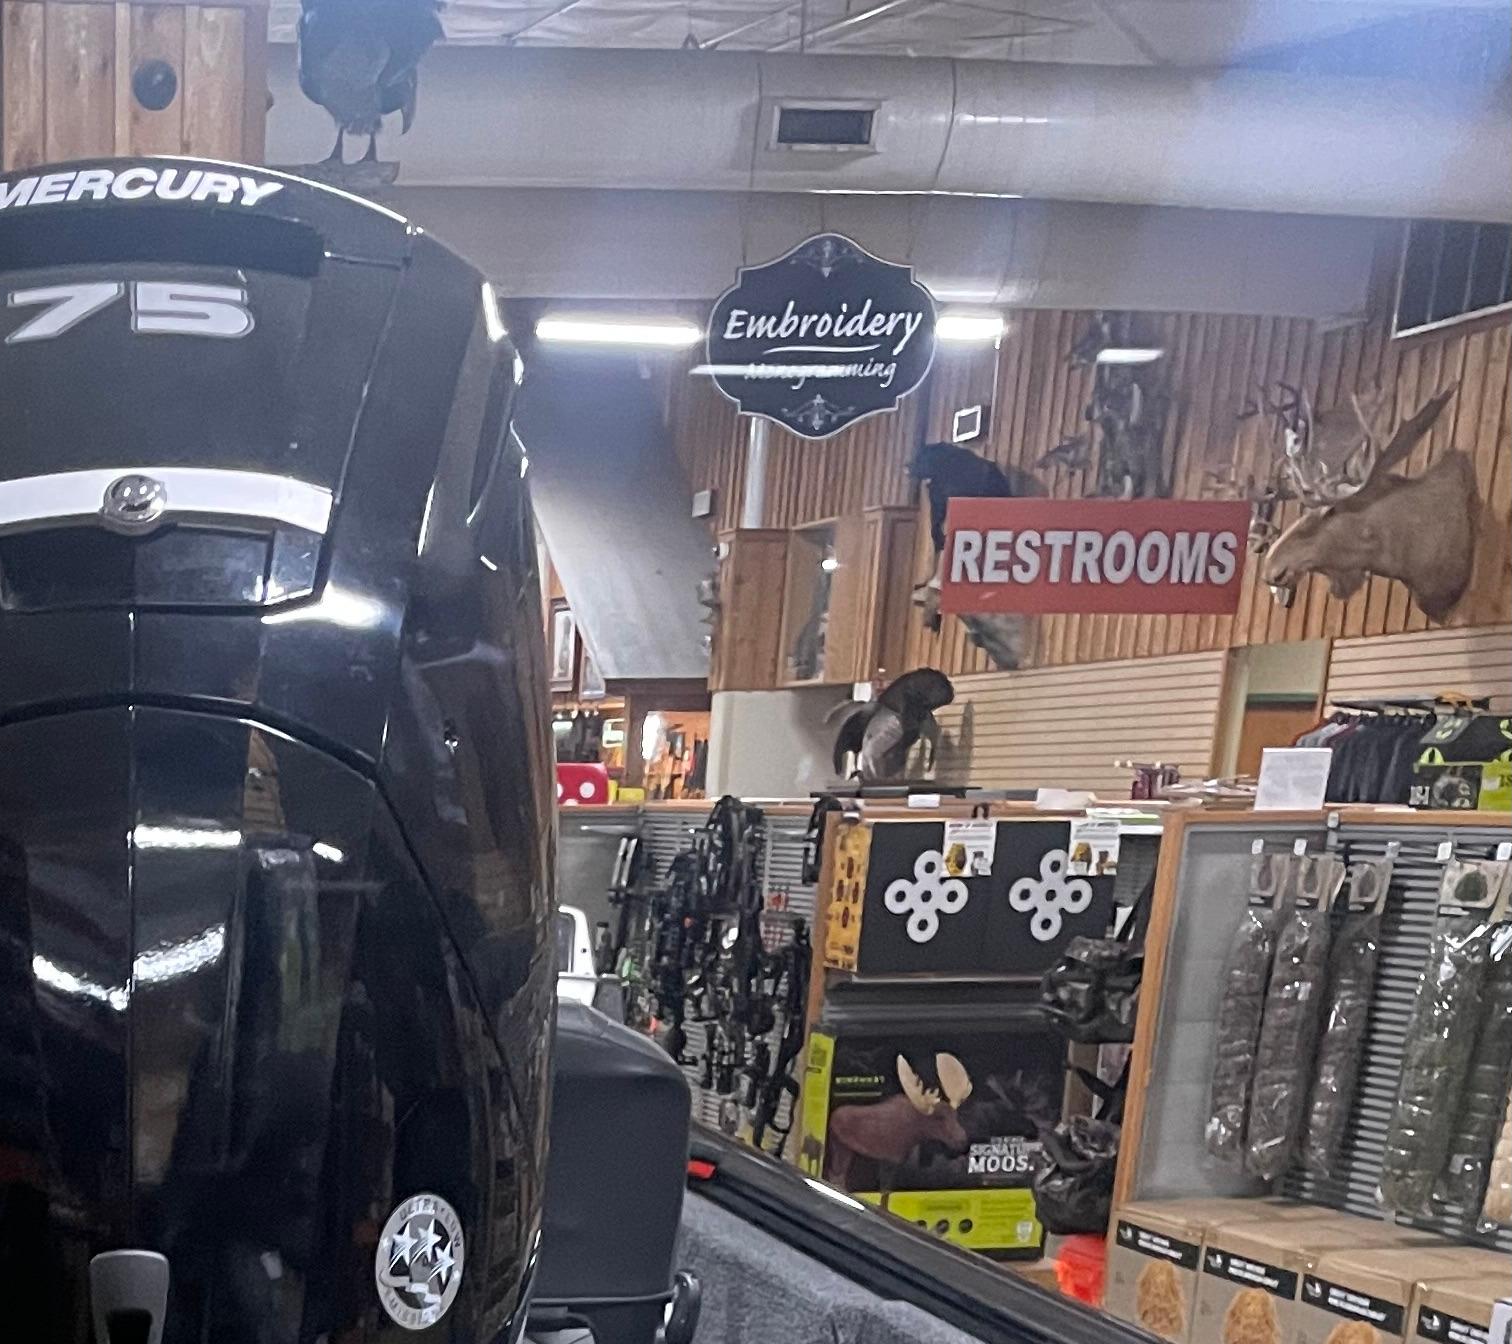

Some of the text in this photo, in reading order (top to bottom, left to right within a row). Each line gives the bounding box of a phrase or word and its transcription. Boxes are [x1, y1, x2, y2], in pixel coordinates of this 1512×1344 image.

[4, 280, 256, 344] 75
[723, 299, 923, 356] Embroidery
[950, 529, 1238, 585] RESTROOMS
